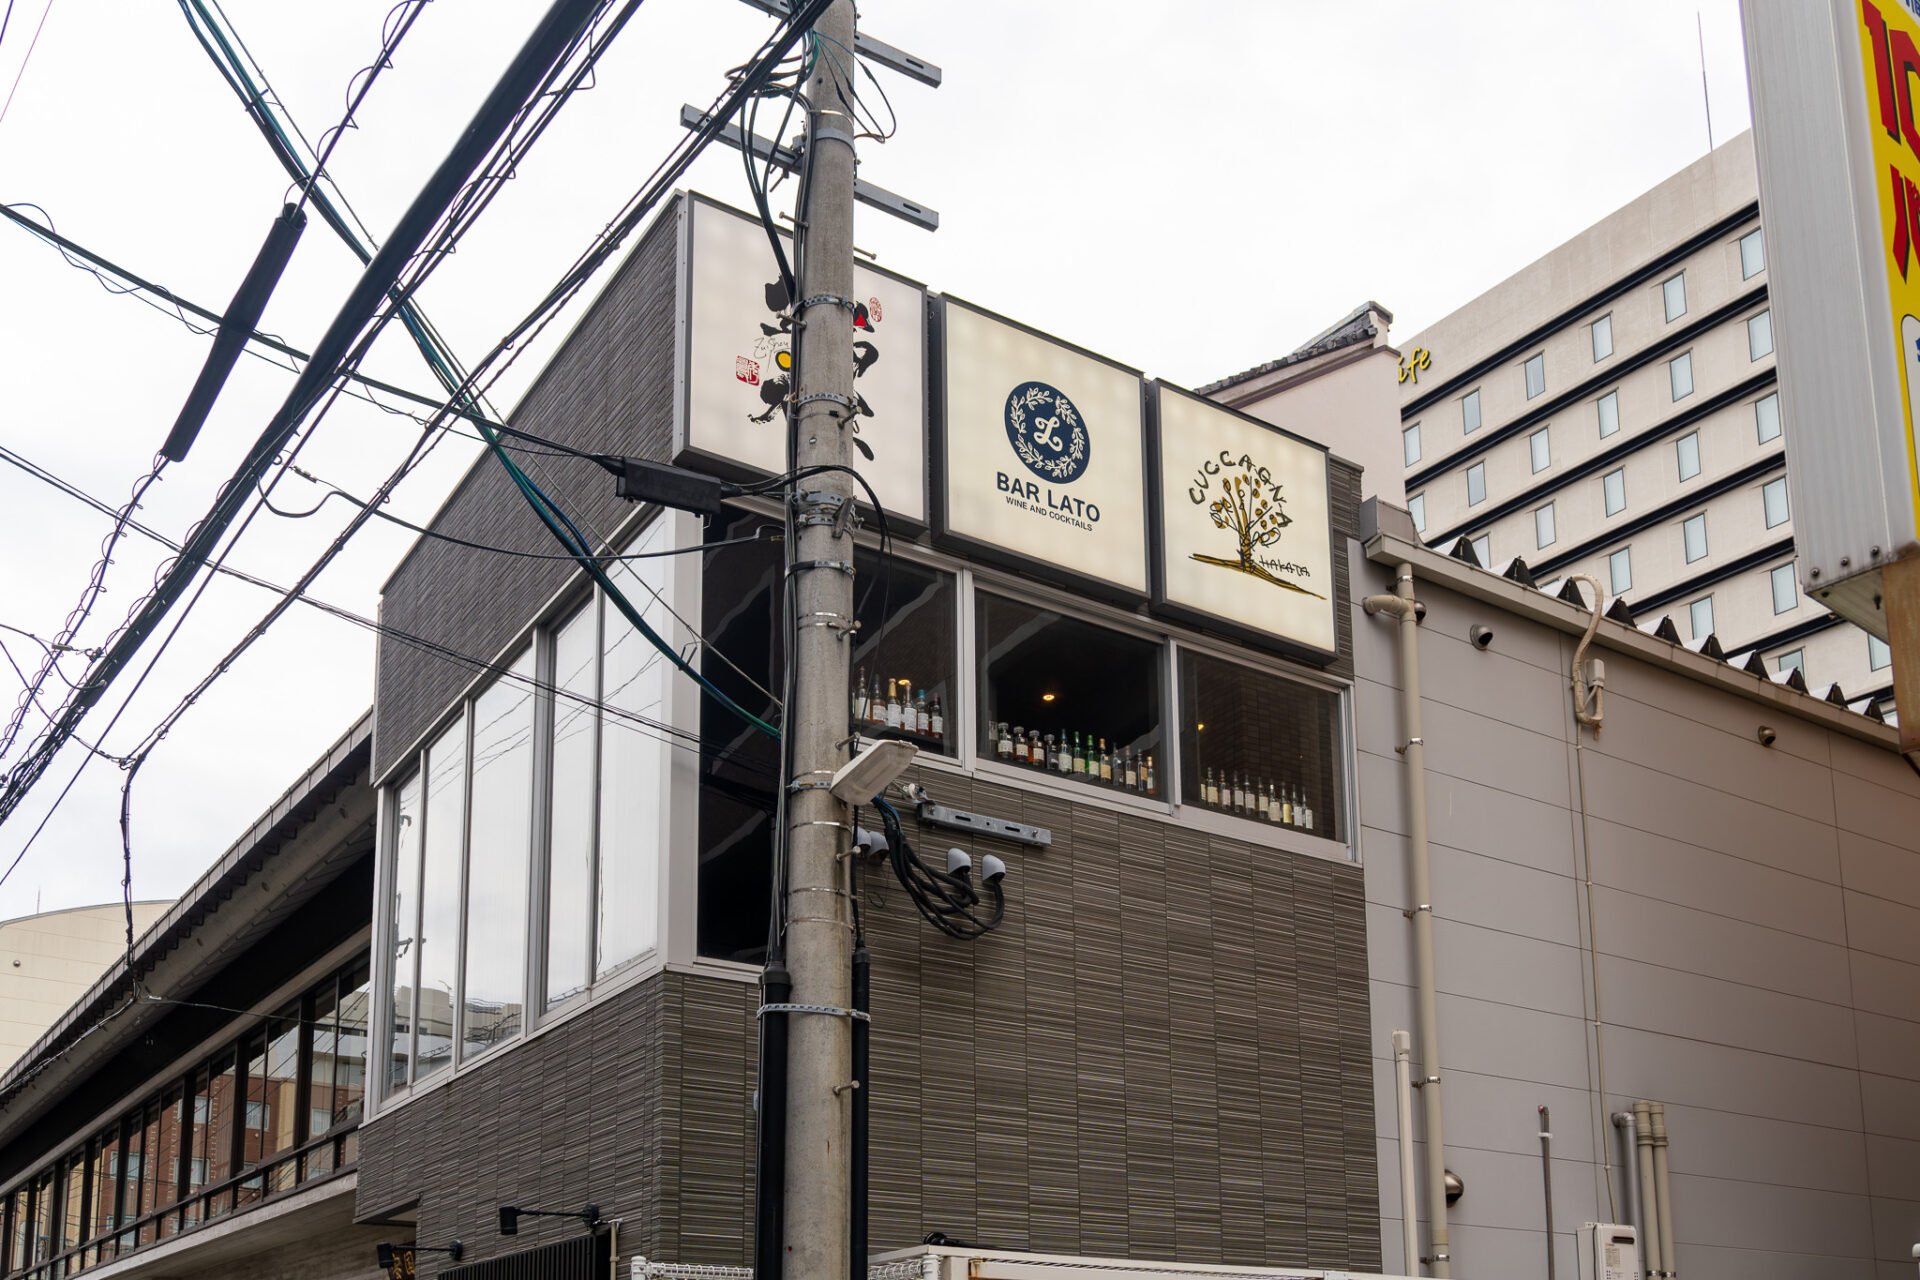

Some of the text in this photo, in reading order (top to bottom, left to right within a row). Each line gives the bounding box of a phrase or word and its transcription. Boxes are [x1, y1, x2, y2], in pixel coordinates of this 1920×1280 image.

[1398, 346, 1432, 384] ife
[996, 471, 1100, 522] BAR LATO
[1006, 496, 1093, 531] WINE AND COCKTAILS
[1259, 555, 1311, 577] HAKATA
